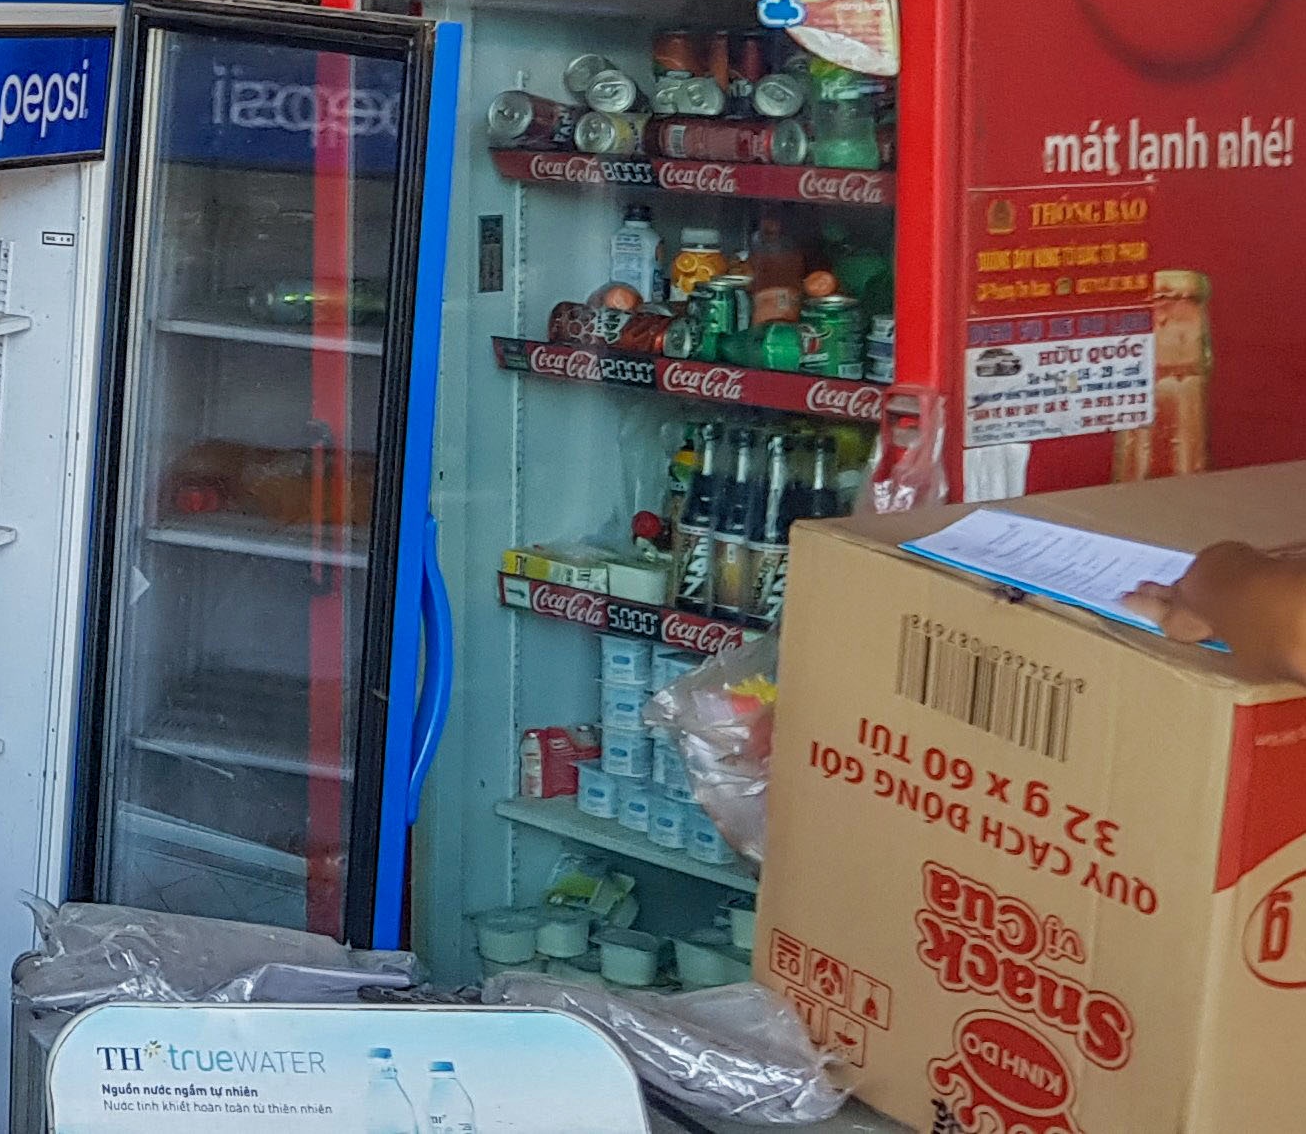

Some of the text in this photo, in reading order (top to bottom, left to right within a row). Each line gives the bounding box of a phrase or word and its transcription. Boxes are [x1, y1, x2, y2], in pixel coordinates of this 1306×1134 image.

[1042, 116, 1296, 181] mát lạnh nhé!
[658, 161, 735, 193] Coca-Cola
[797, 169, 883, 204] Coca-Cola
[662, 361, 746, 401] Coca-Cola
[806, 378, 883, 421] Coca-Col
[532, 584, 605, 626] Coca-Cola
[856, 717, 1121, 858] 32 g x 60 TÚI
[809, 740, 1159, 916] QUY CÁCH ĐÓNG GÓI
[929, 869, 1039, 955] Cua
[919, 917, 1129, 1063] Snack
[96, 1045, 145, 1072] TH
[225, 1084, 259, 1097] nhiên
[300, 1103, 333, 1115] nhiên
